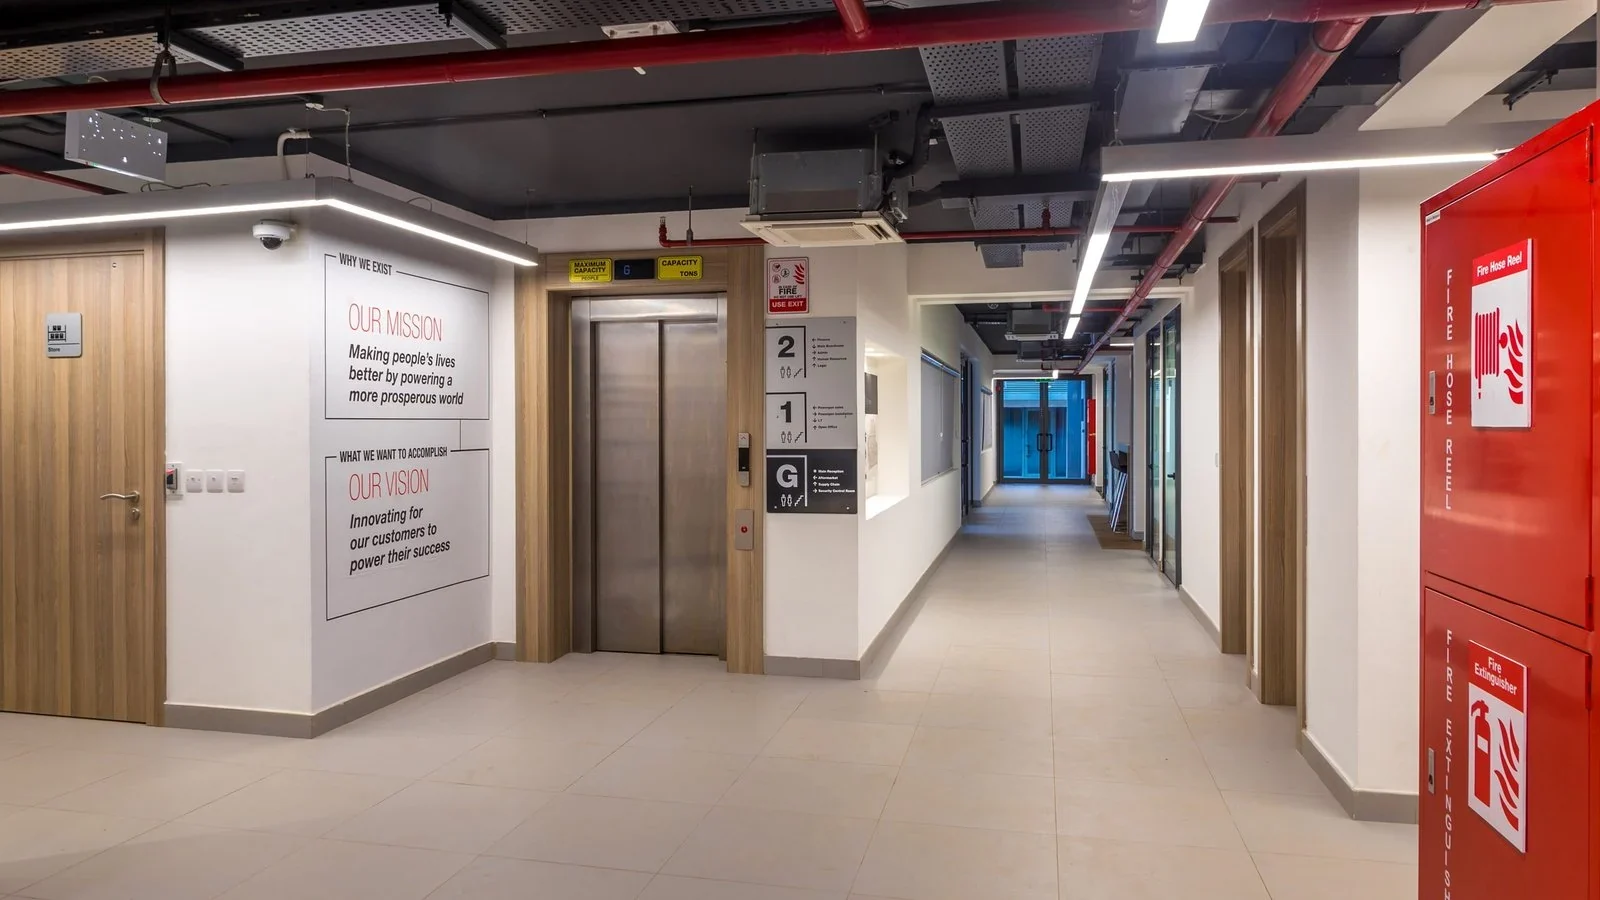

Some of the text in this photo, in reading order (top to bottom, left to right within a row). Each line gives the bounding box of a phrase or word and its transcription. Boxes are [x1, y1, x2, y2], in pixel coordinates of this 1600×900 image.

[339, 252, 392, 276] WHY WE EXIST
[661, 259, 698, 267] CAPACITY
[1477, 250, 1523, 277] Fire Hose Reel
[778, 287, 797, 295] FIRE
[348, 302, 442, 342] OUR MISSION
[348, 343, 390, 365] Making
[435, 353, 456, 368] lives
[777, 335, 795, 358] 2
[348, 365, 453, 388] better by powering a
[348, 389, 464, 406] more prosperous world
[1444, 268, 1454, 510] FIRE HOSE REEL
[780, 400, 792, 423] 1
[339, 446, 448, 463] WHAT WE WANT TO ACCOMPLISH
[349, 468, 429, 501] OUR VISION
[776, 464, 798, 488] G
[350, 506, 423, 529] Innovating for
[350, 523, 437, 551] our customers to
[349, 540, 451, 576] power their success
[1488, 656, 1502, 674] Fire
[1474, 662, 1518, 695] Extinguisher
